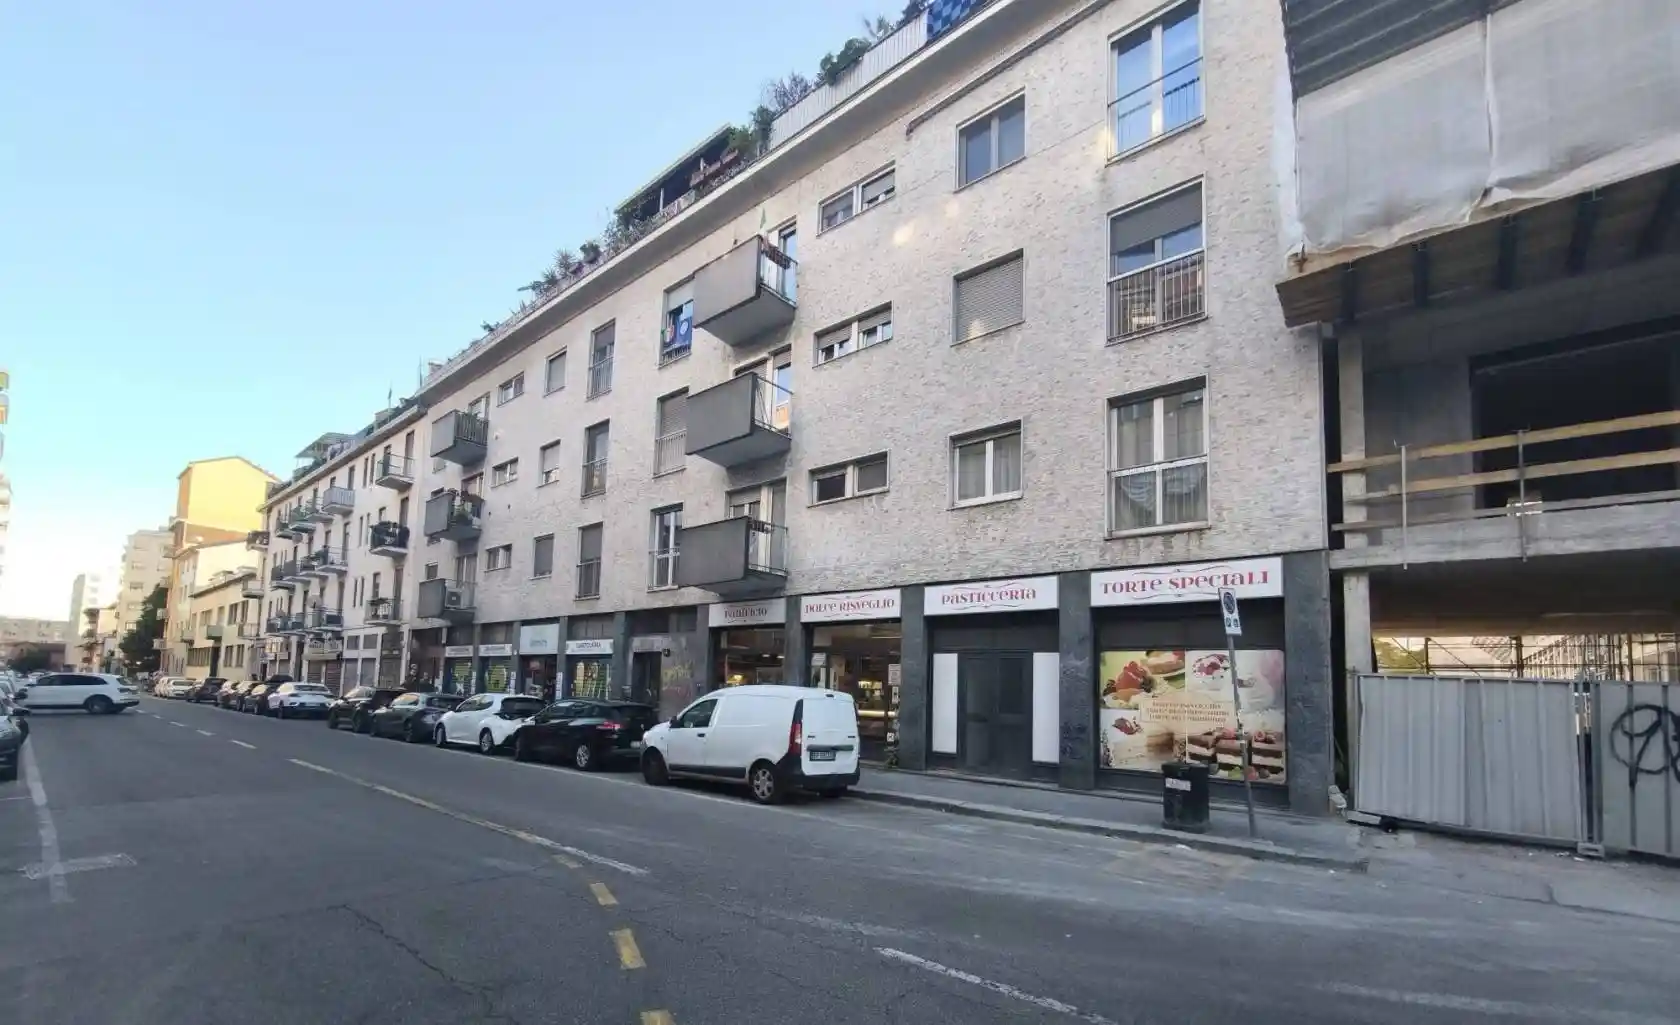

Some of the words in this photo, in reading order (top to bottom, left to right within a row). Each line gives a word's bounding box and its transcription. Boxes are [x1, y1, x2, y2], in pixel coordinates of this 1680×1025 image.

[1100, 578, 1162, 594] TORTE
[1169, 571, 1269, 590] SPECIALI
[942, 588, 1037, 605] PASTICCERIA
[804, 602, 837, 614] DOLCE
[839, 599, 895, 612] RISVEGLIO
